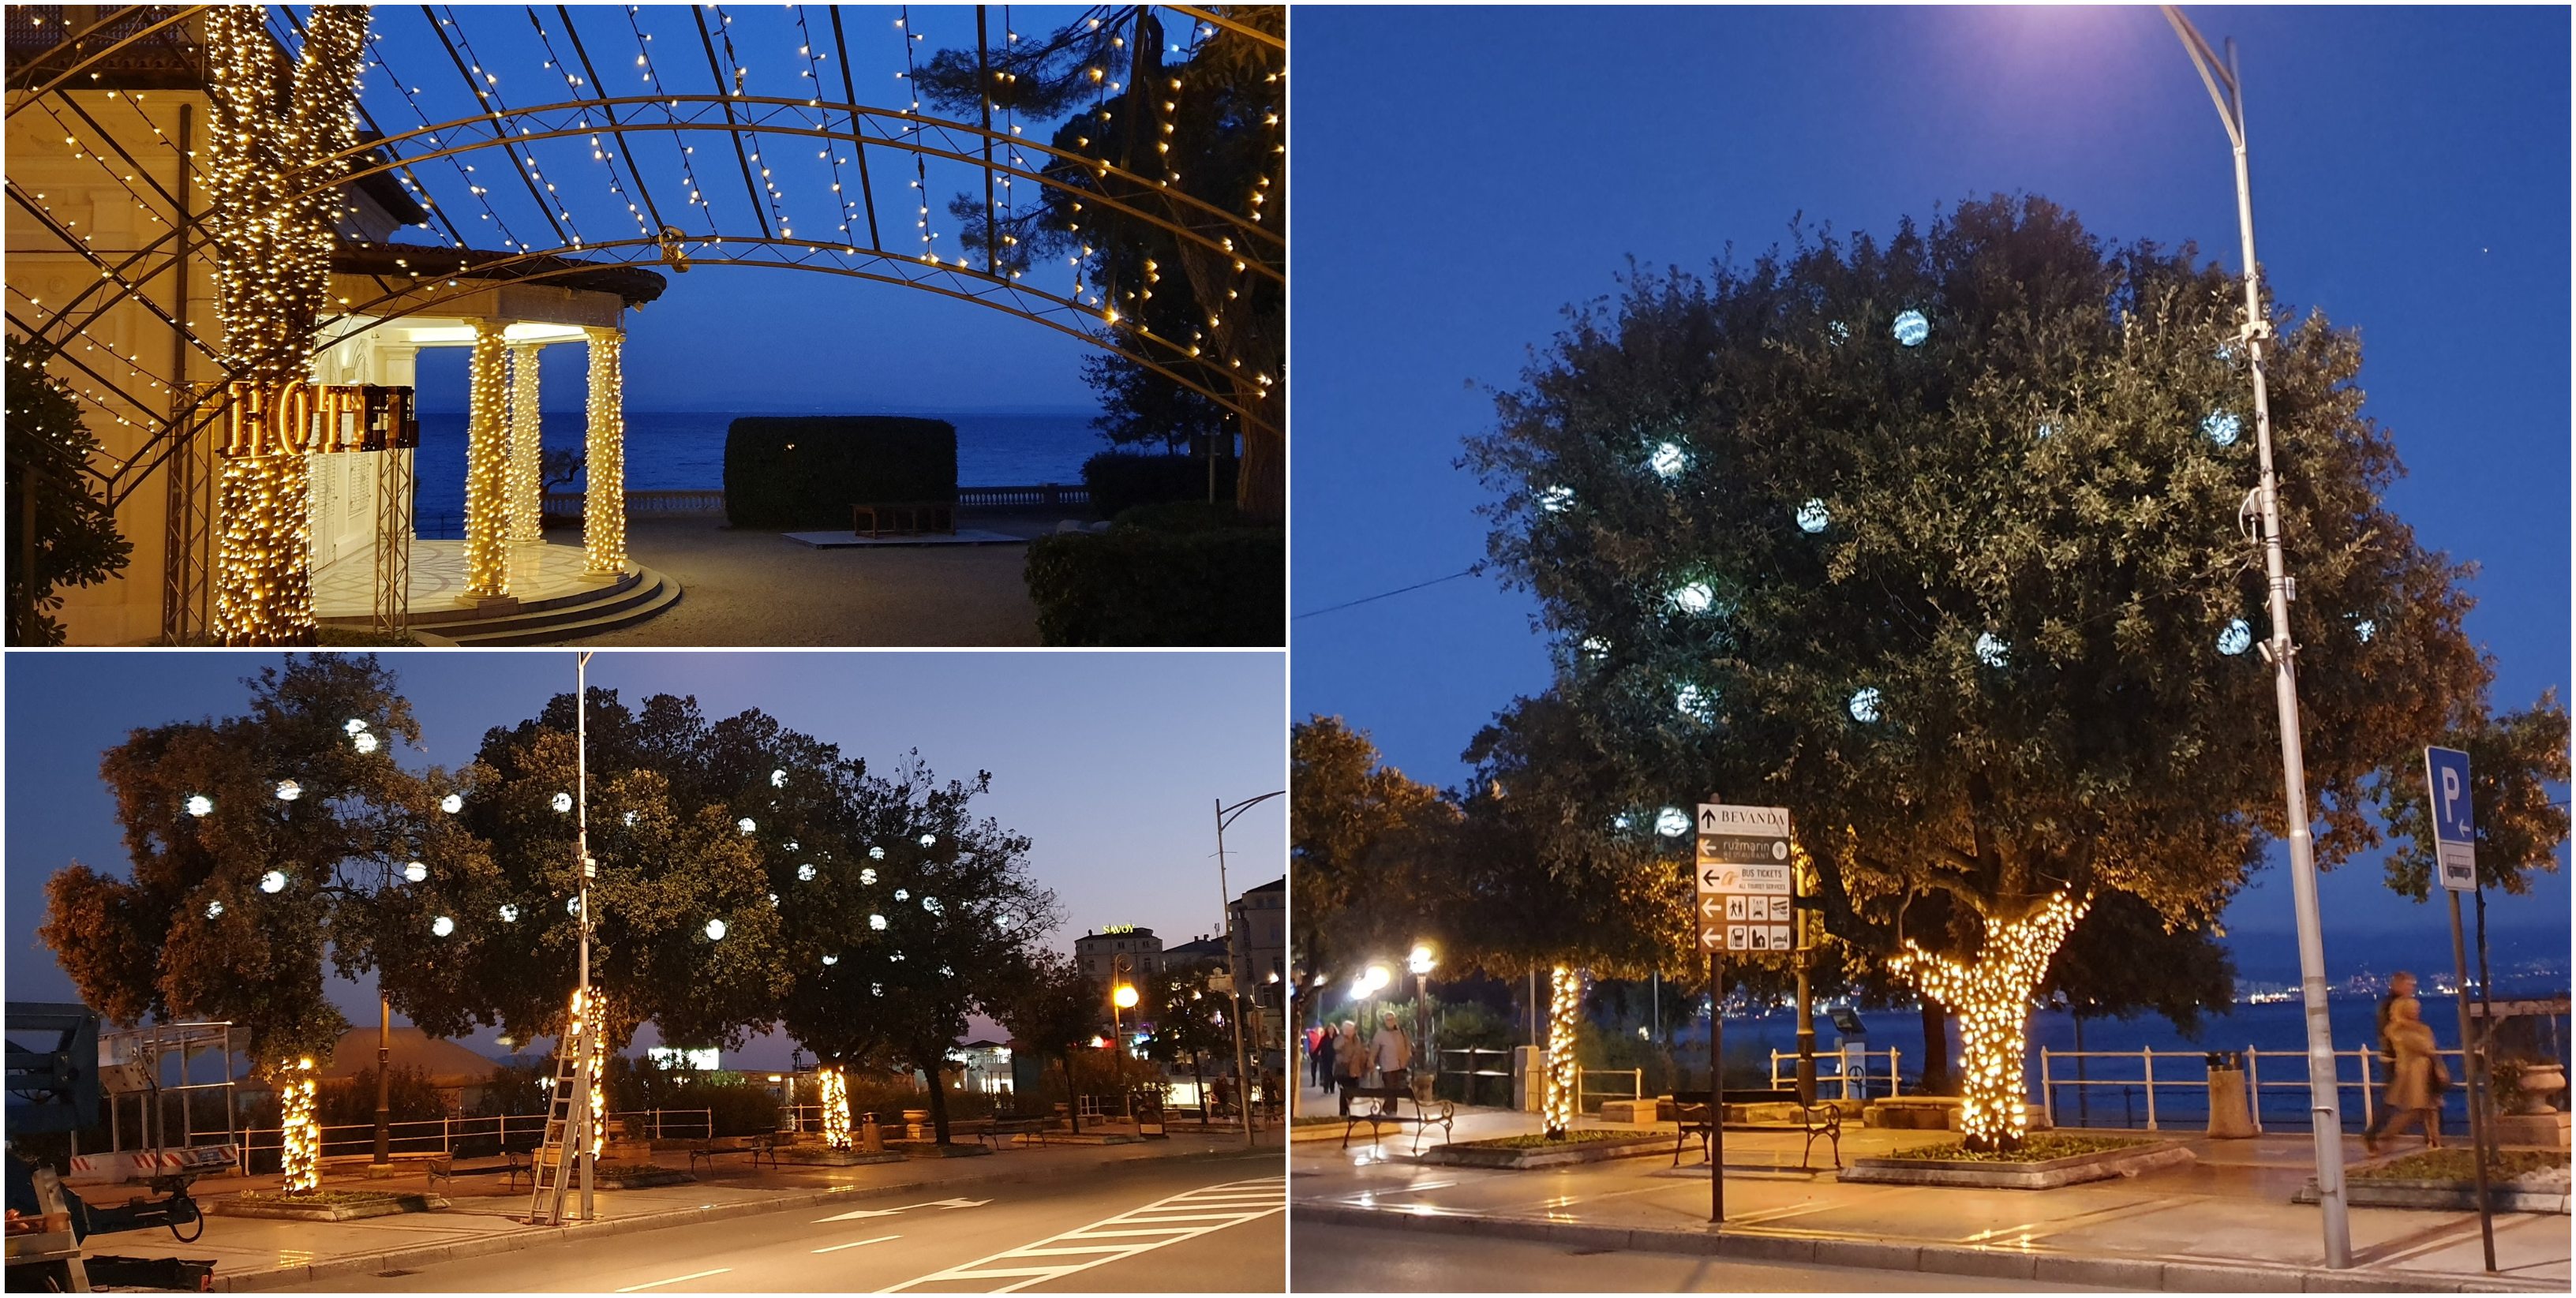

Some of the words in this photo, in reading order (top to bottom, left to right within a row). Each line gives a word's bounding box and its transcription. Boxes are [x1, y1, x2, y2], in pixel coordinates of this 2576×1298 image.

[224, 379, 419, 458] HOTEL
[2442, 766, 2460, 823] P
[1722, 810, 1784, 825] BEVANDA
[1723, 838, 1770, 852] ružmarin
[1742, 868, 1755, 877] BUS
[1757, 869, 1782, 878] TICKETS
[1103, 922, 1136, 934] SAVOY
